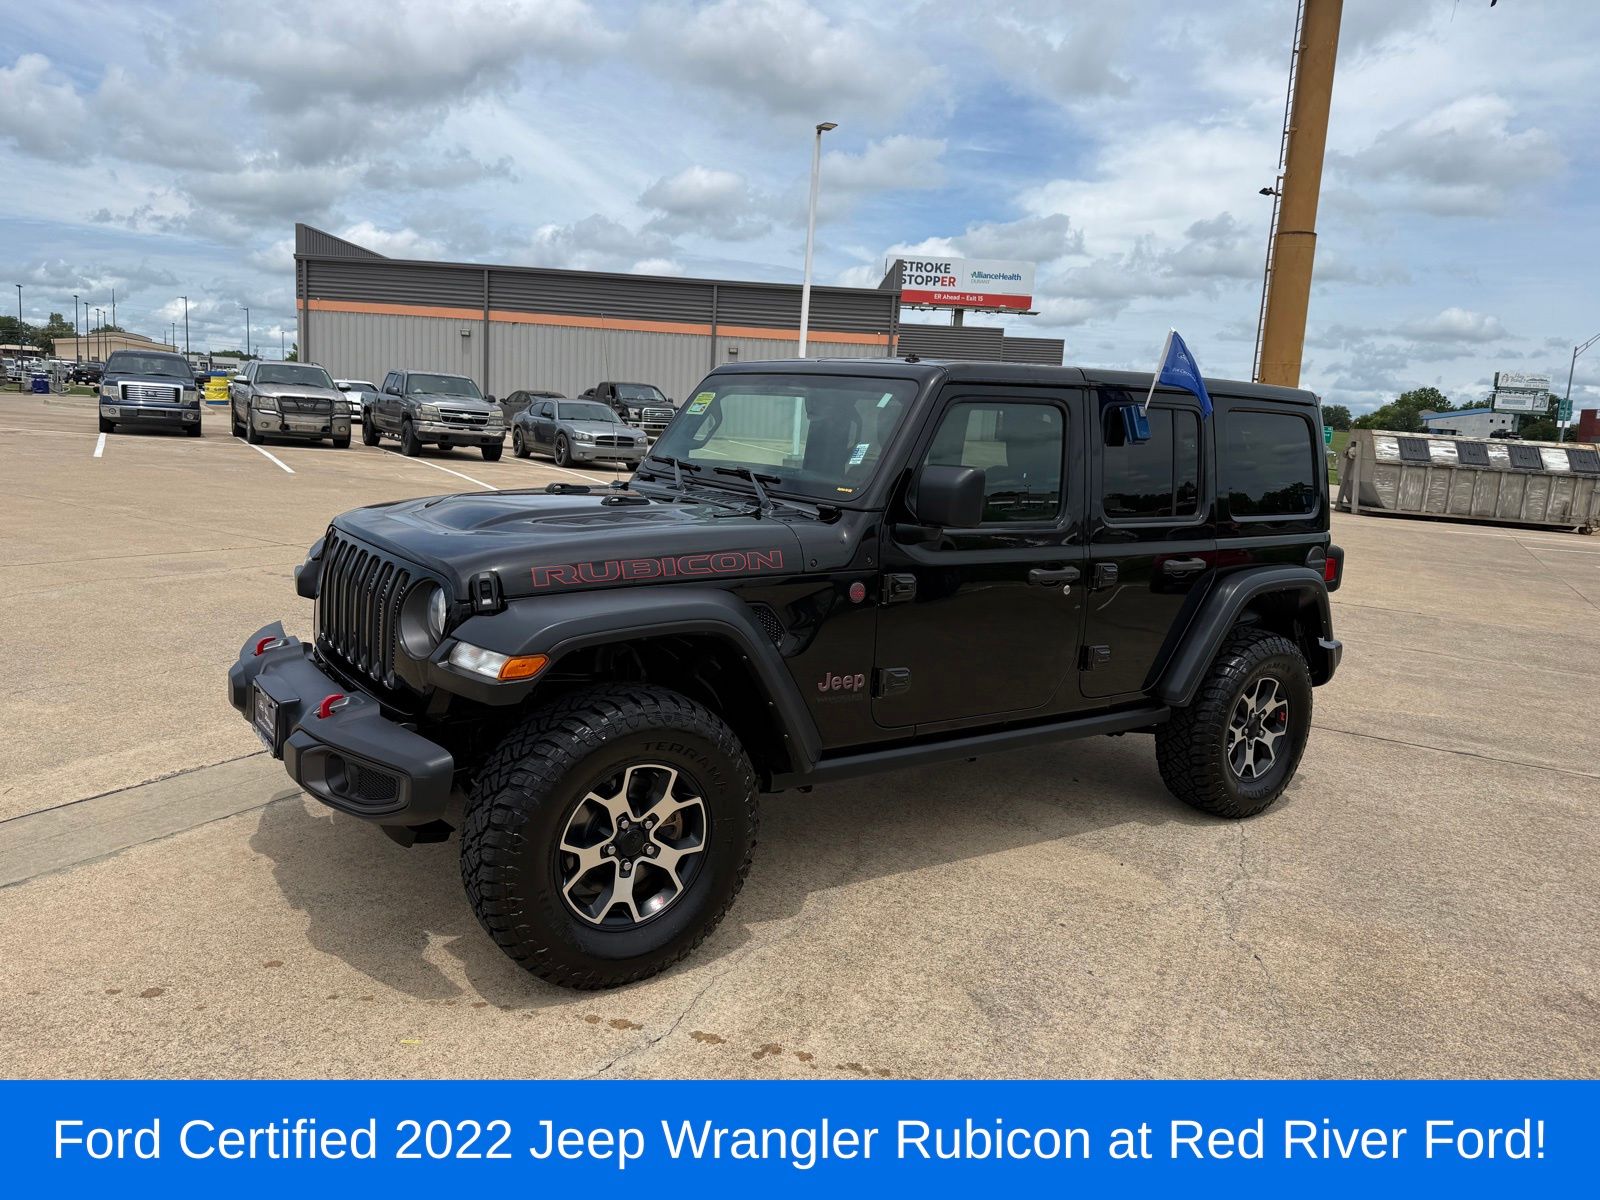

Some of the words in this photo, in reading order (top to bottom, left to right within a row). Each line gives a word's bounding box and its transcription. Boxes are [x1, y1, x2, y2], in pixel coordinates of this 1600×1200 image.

[902, 261, 951, 274] STROKE
[902, 274, 956, 287] STOPPER
[971, 271, 1022, 281] AllianceHealth
[531, 550, 784, 587] RUBICON
[817, 671, 866, 693] Jeep
